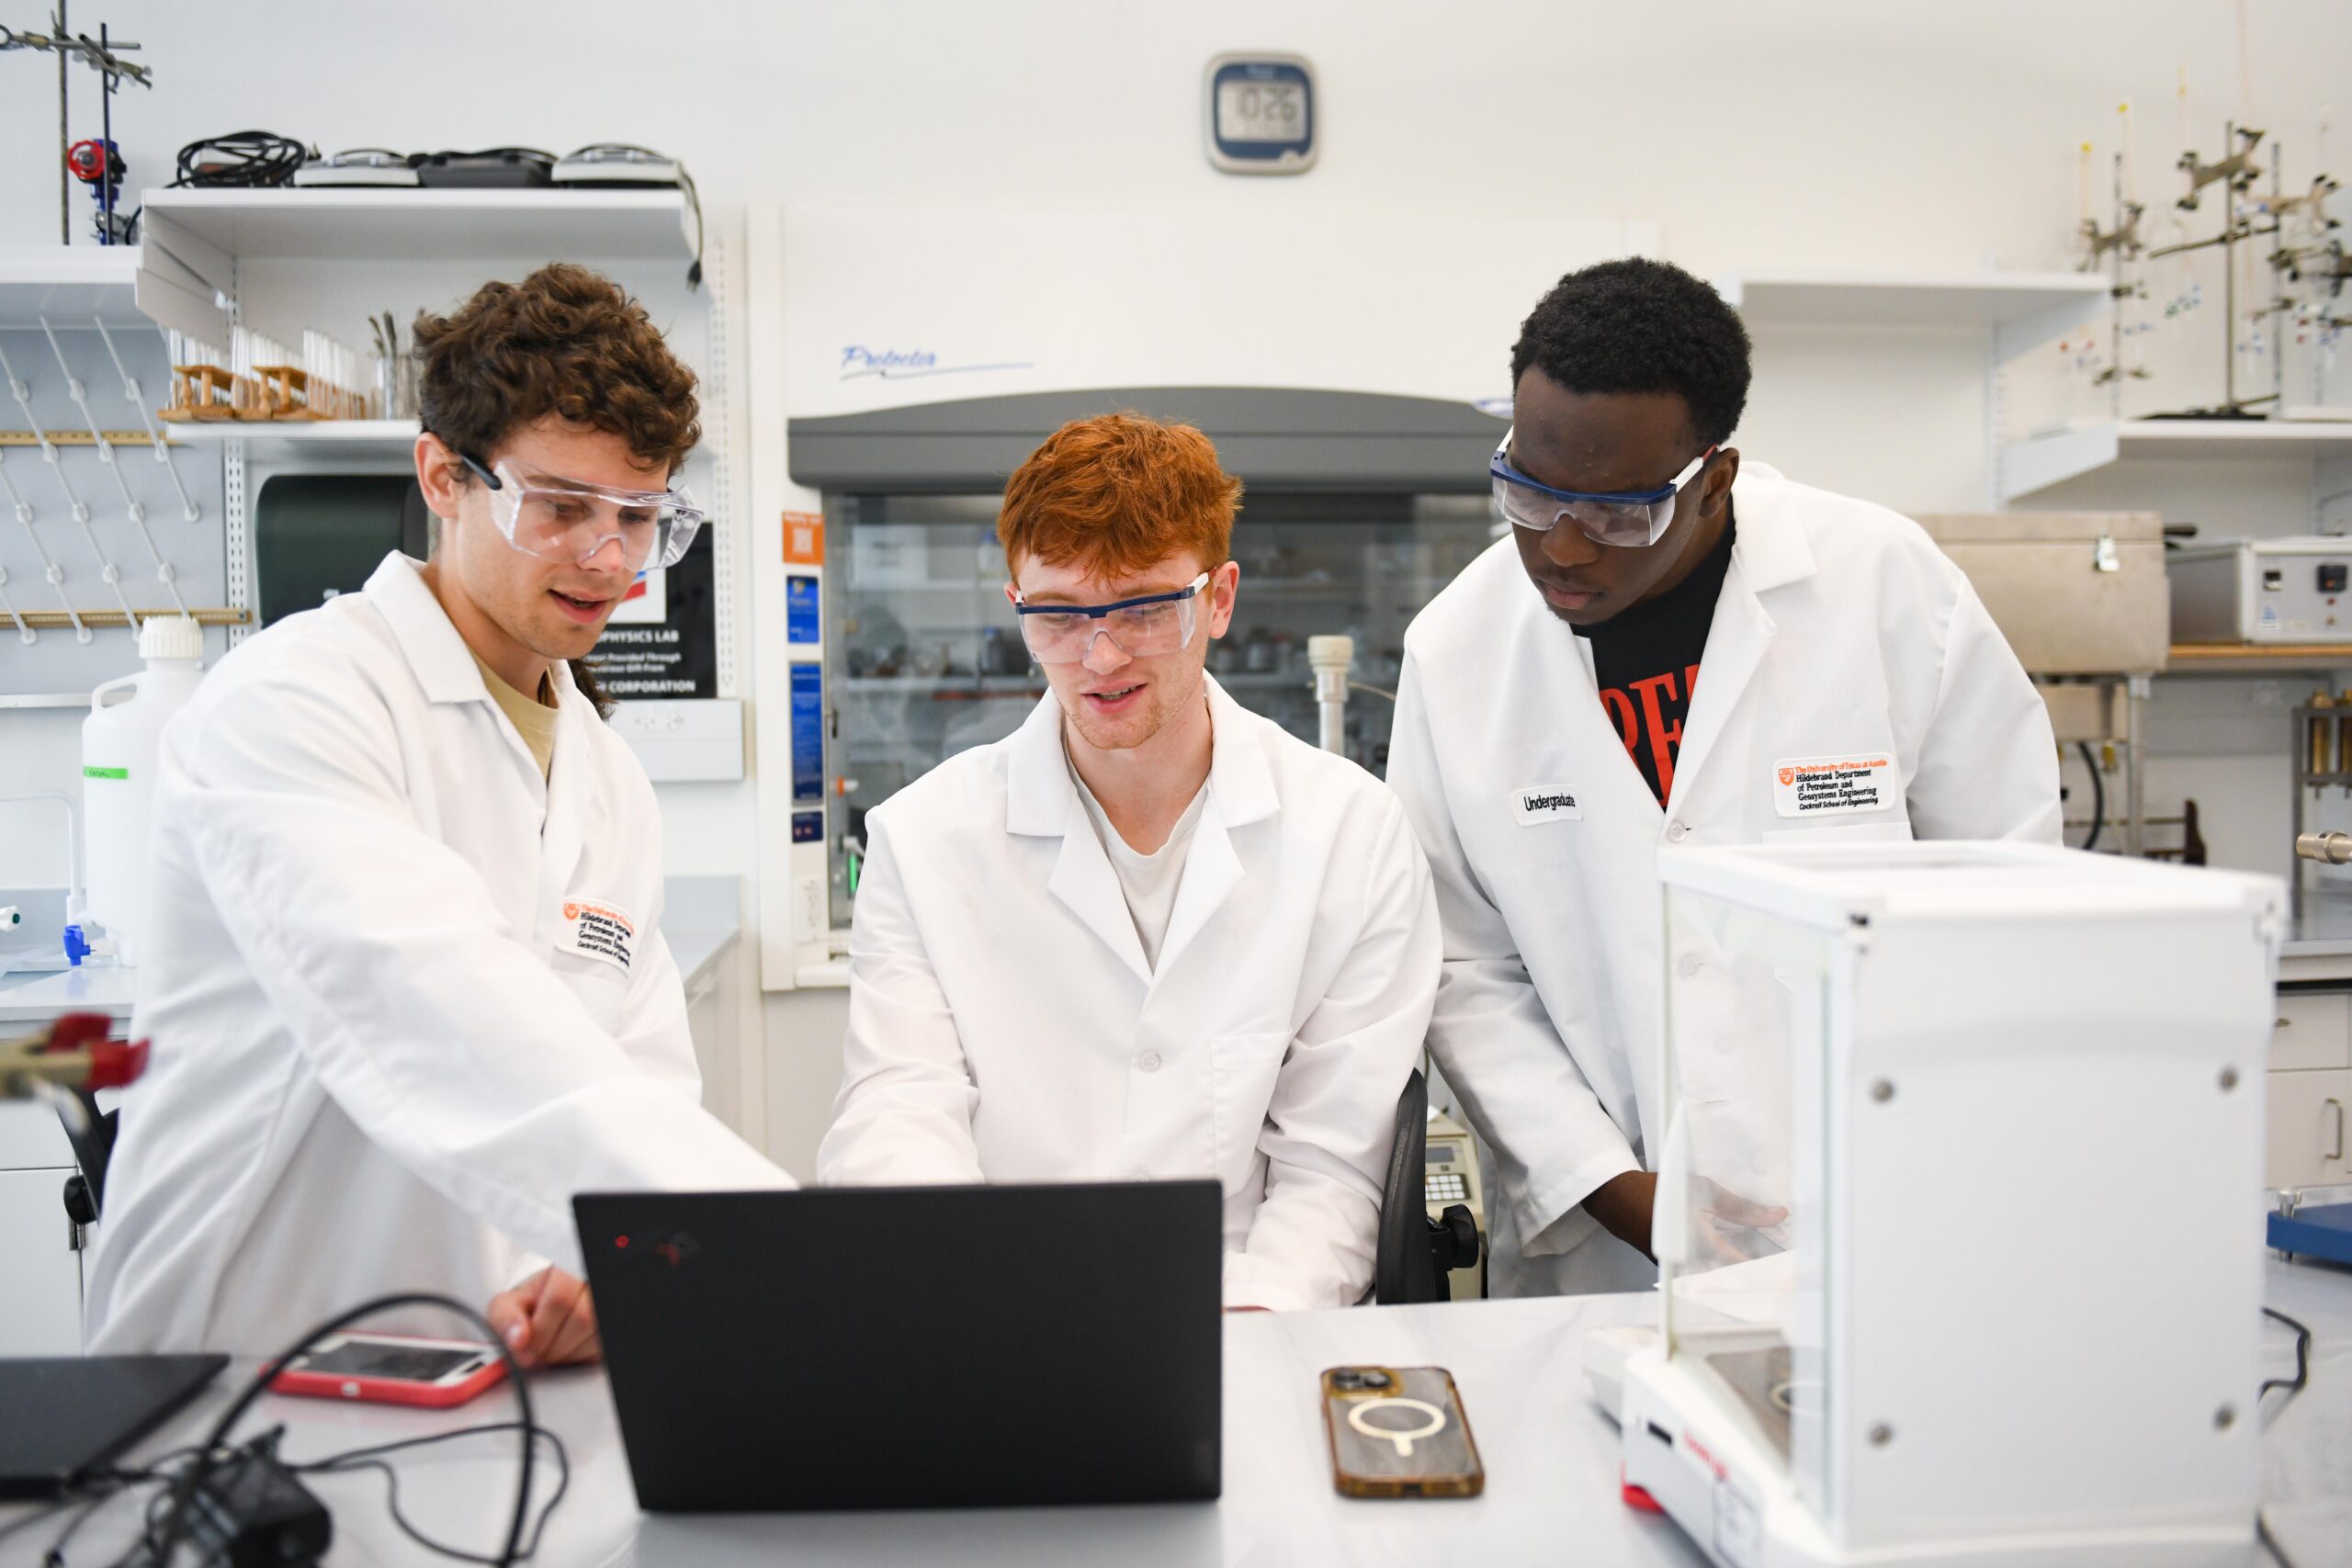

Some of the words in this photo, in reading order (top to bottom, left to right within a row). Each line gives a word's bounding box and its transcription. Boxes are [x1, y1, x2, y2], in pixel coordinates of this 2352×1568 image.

[842, 344, 936, 367] Protector
[654, 630, 680, 643] LAB
[608, 680, 696, 693] CORPORATION
[1806, 763, 1838, 773] University
[1796, 772, 1833, 783] Hildebrand
[1835, 769, 1871, 780] Department
[1797, 784, 1804, 792] of
[1806, 782, 1838, 791] Petroleum
[1840, 779, 1853, 789] and
[1798, 790, 1837, 802] Geosystems
[1838, 785, 1877, 798] Engineering
[1823, 798, 1840, 808] School
[1847, 795, 1879, 807] Engineering
